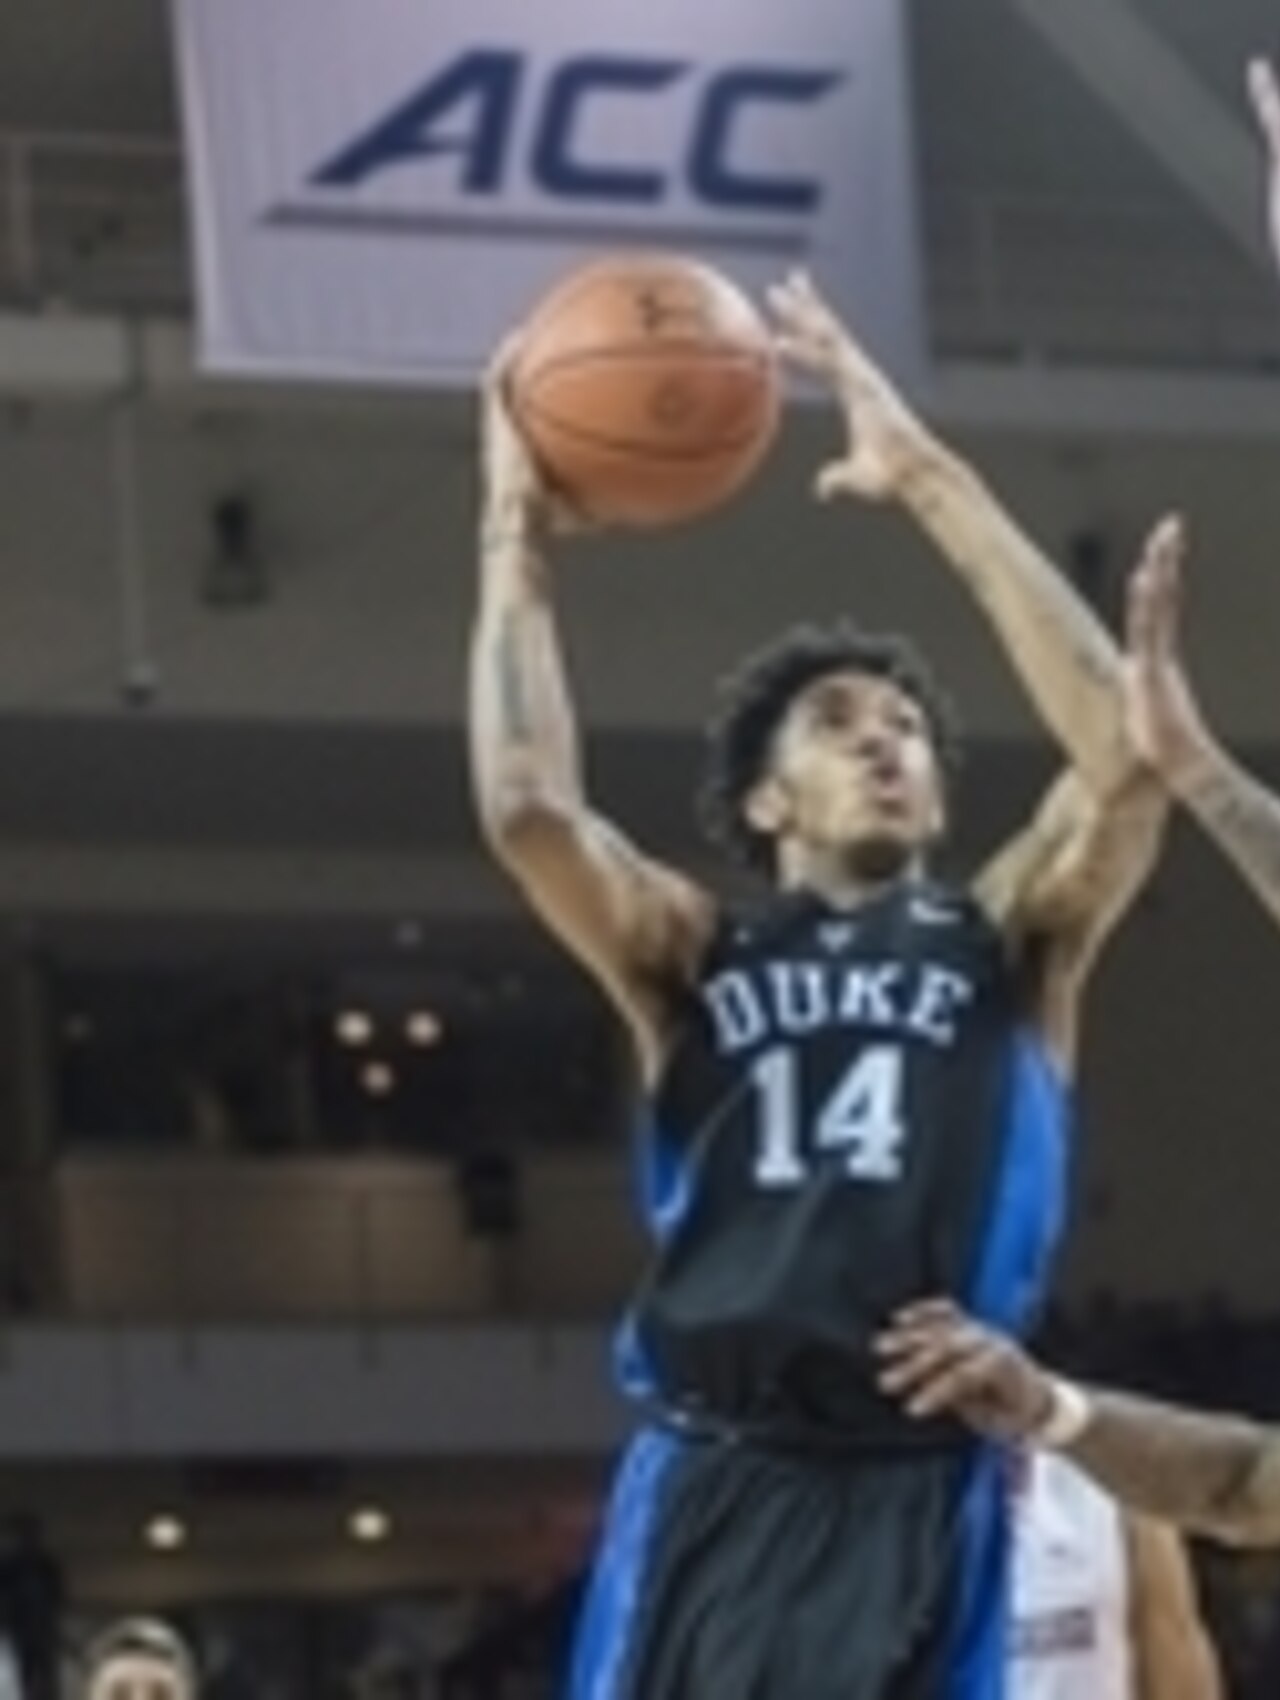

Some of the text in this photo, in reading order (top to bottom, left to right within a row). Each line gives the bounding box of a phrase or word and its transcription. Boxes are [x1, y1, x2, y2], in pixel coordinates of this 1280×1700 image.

[307, 48, 847, 212] ACC
[704, 960, 973, 1054] DUKE
[752, 1044, 905, 1185] 14
